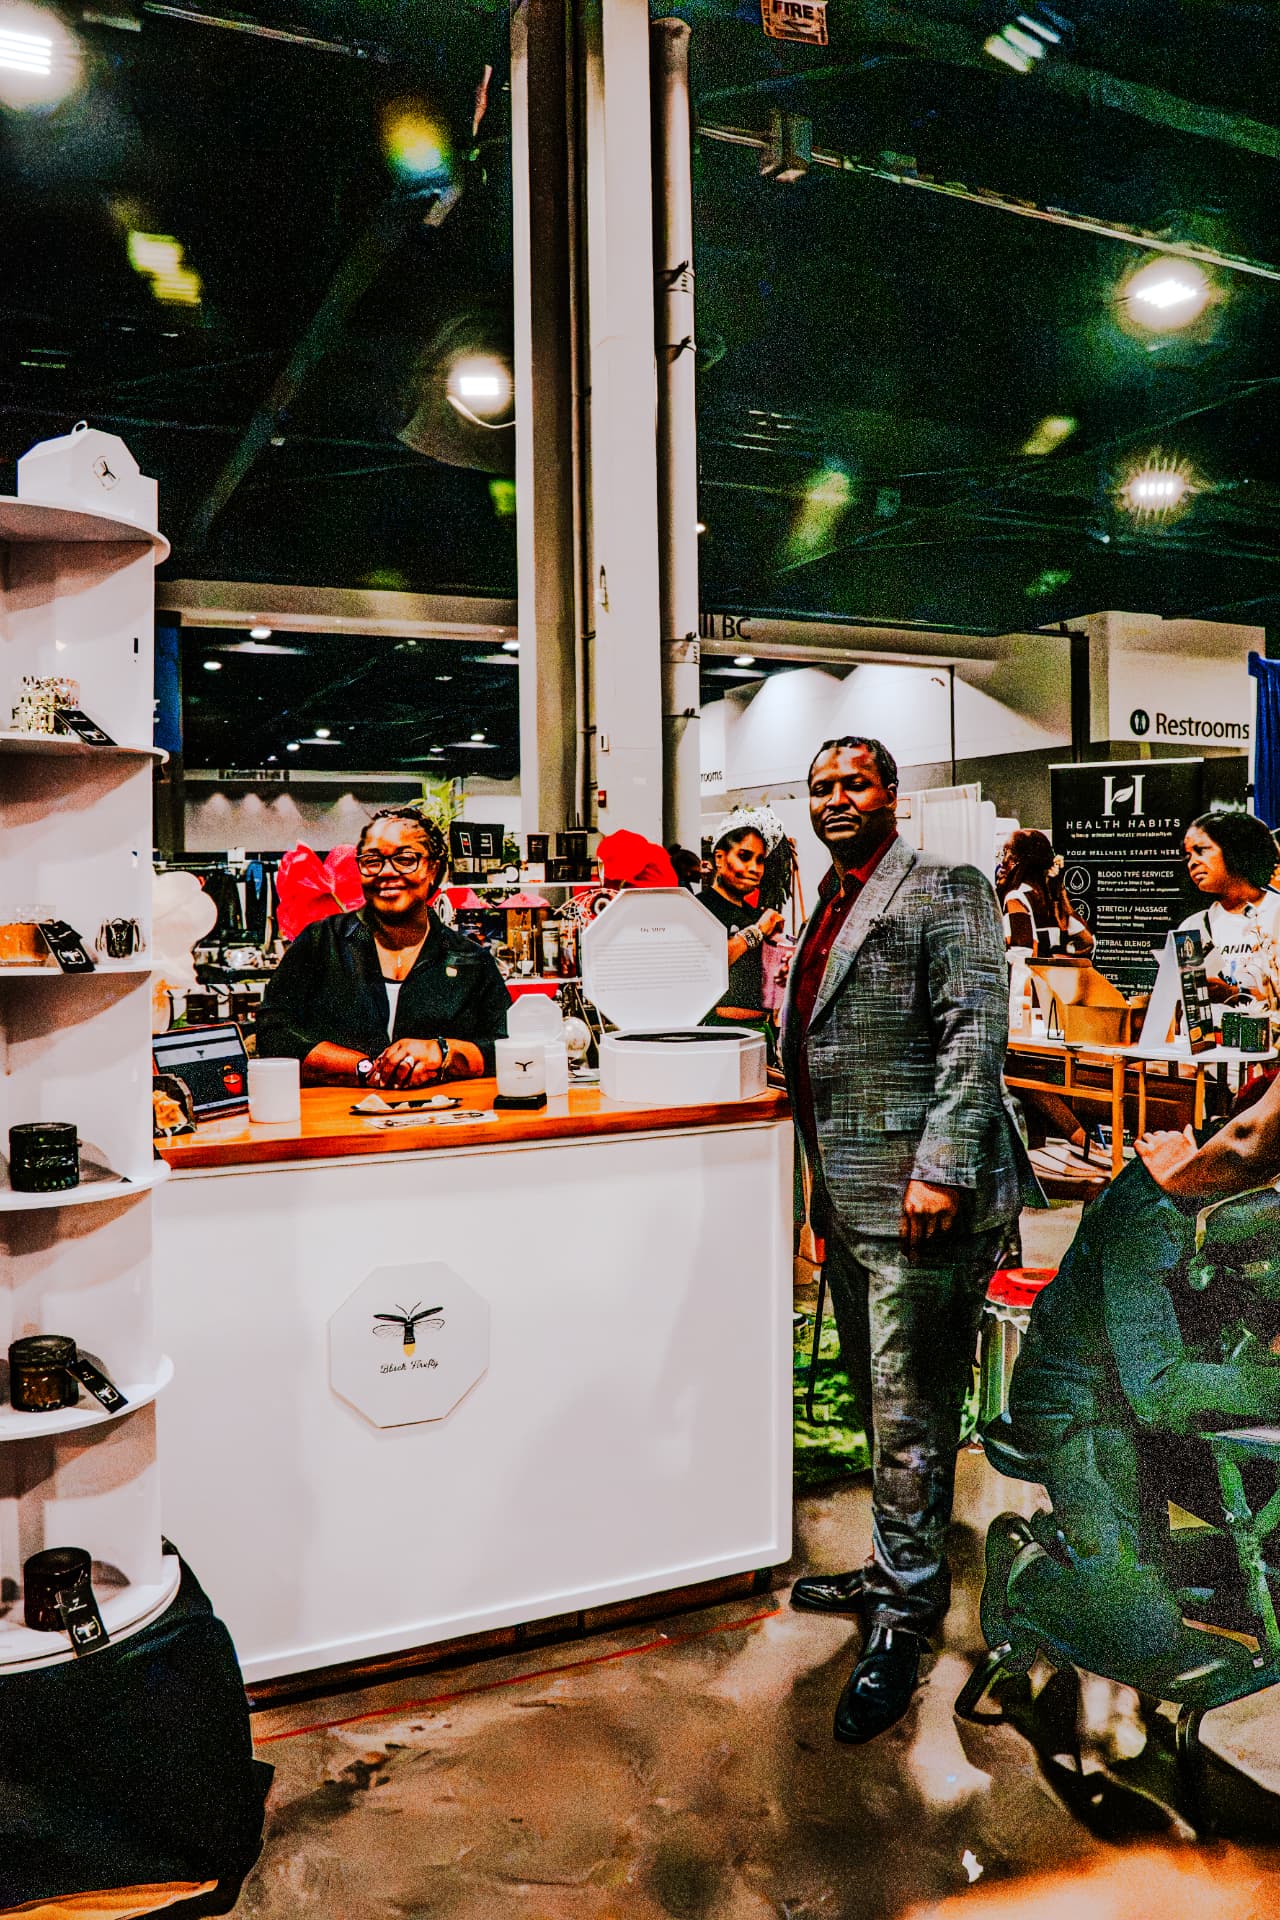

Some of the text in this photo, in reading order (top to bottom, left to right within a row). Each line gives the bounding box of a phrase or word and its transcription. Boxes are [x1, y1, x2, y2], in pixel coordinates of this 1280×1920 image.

[773, 0, 815, 19] FIRE
[722, 615, 752, 639] BC
[1156, 712, 1250, 739] Restrooms
[1066, 818, 1181, 830] HEALTH HABITS
[1066, 848, 1180, 856] YOUR WELLNESS STARTS HERE
[1097, 870, 1174, 878] BLOOD TYPE SERVICES
[1096, 905, 1127, 913] STRETCH
[1096, 939, 1151, 948] HERBAL BLENDS
